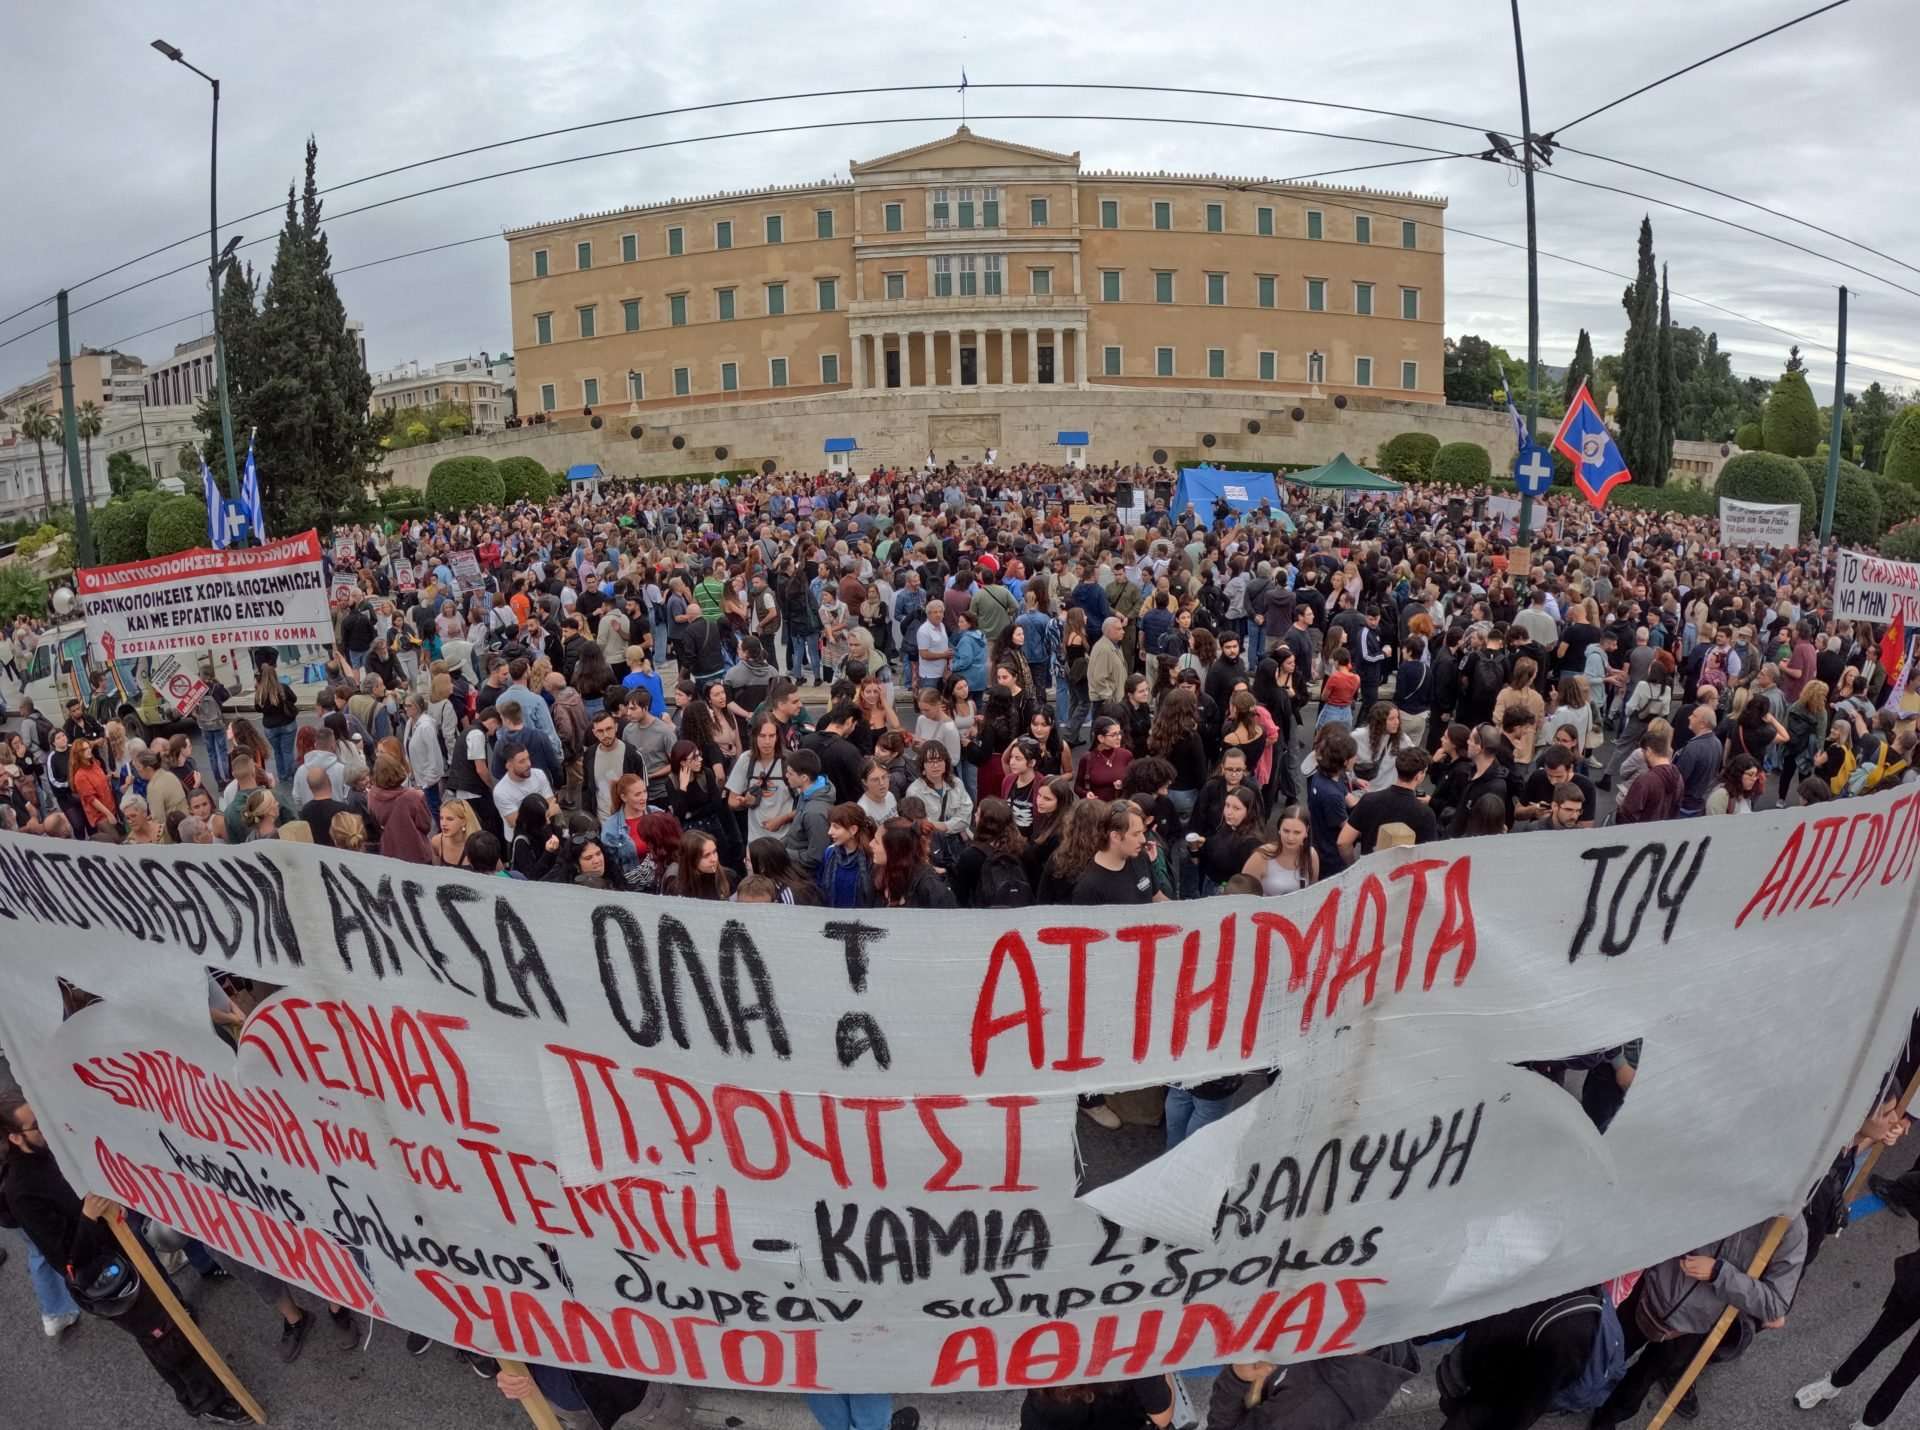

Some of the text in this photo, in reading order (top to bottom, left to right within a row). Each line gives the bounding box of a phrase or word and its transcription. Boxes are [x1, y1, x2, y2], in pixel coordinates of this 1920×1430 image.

[103, 554, 224, 585] ΙΔΙΩΤΙΚΟΠΟΙΗΣΕΙΣ
[1842, 553, 1858, 584] ΤΟ
[86, 569, 322, 617] ΚΡΑΤΙΚΟΠΟΙΗΣΕΙΣ ΧΩΡΙΣ ΑΠΟΖΗΜΙΩΣΗ
[1840, 588, 1920, 622] ΝΑ ΜΗΝ ΣΥΓΚ
[127, 600, 285, 632] ΚΑΙ ΜΕ ΕΡΓΑΤΙΚΟ ΕΛΕΓΧΟ
[121, 626, 317, 654] ΣΟΣΙΑΛΙΣΤΙΚΟ ΕΡΓΑΤΙΚΟ ΚΟΜΜΑ
[0, 842, 305, 969] ΑΝΟΠΟΙΗΘΟΥΝ
[591, 904, 792, 1061] ΟΛΑ
[970, 855, 1477, 1077] ΑΙΤΗΜΑΤΑ
[1567, 836, 1712, 964] ΤΟΥ
[312, 1118, 378, 1170] για
[389, 1136, 463, 1194] τα
[457, 1136, 740, 1271] ΤΕΜΠΗ
[815, 1199, 1050, 1285] ΚΑΜΙΑ
[922, 1225, 1384, 1321] σιδηρόδρομος
[414, 1268, 833, 1391] ΣΥΛΛΟΓΟΙ
[930, 1277, 1389, 1388] ΑΘΗΝΑΣ
